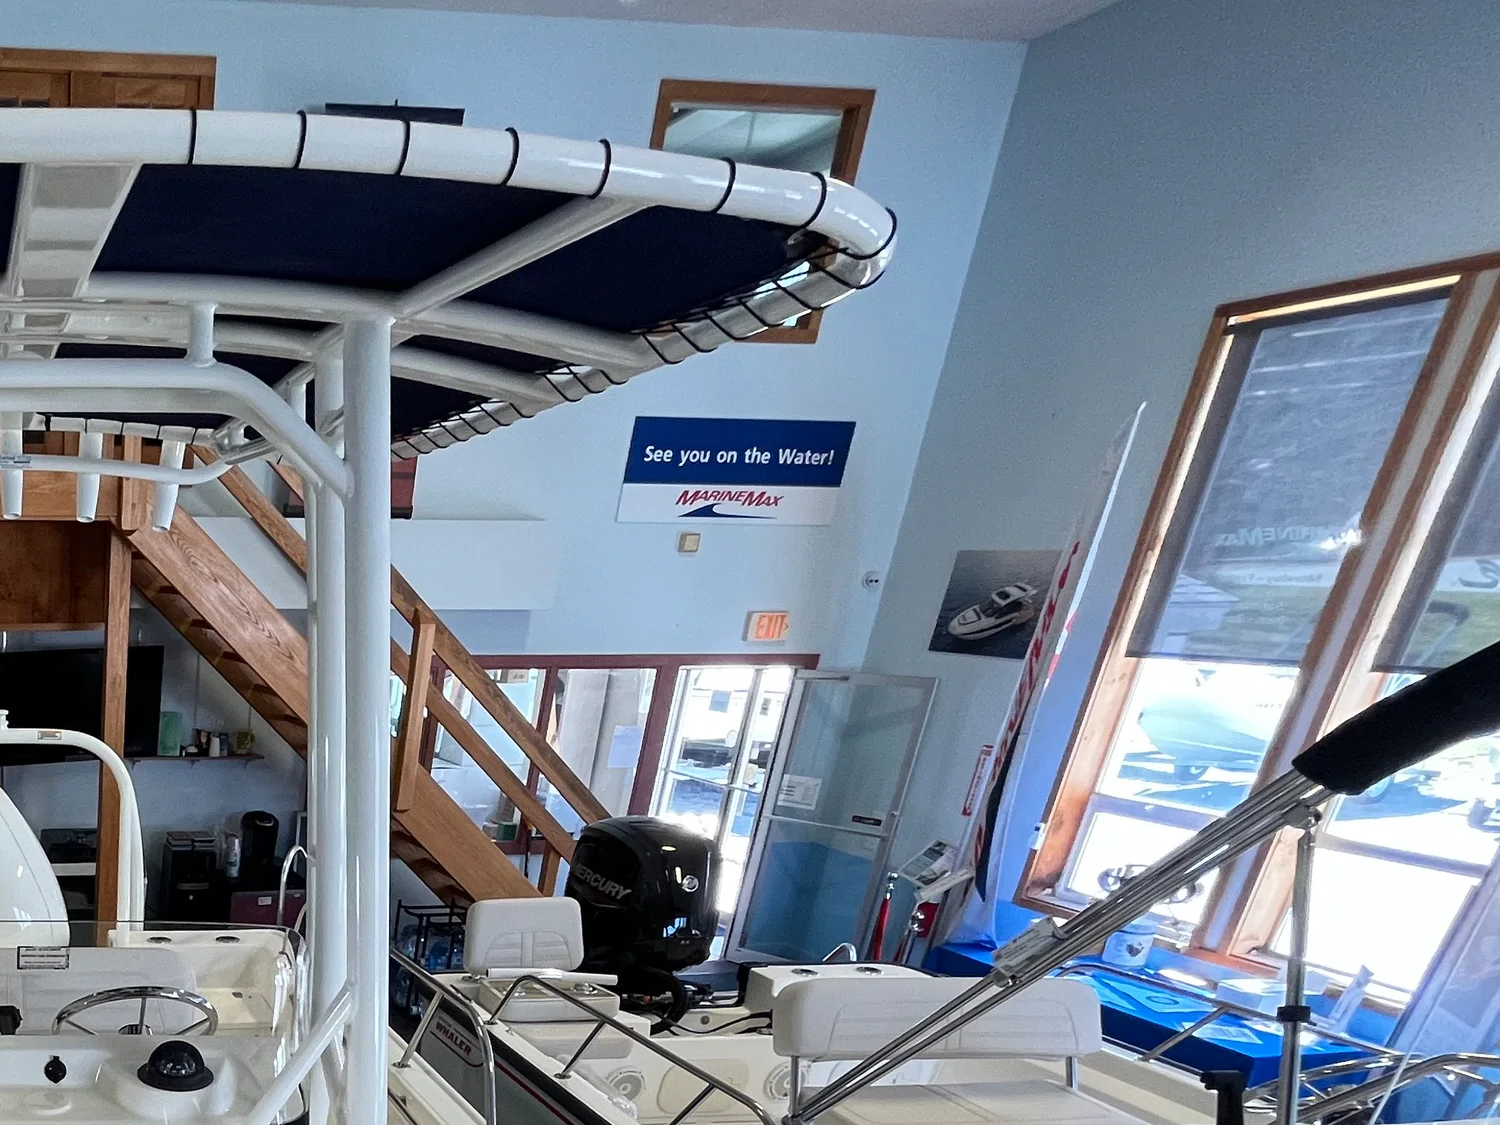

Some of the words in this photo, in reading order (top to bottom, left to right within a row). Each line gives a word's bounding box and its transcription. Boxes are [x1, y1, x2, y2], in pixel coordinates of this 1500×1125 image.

[643, 446, 673, 462] See
[679, 450, 711, 467] you
[716, 450, 738, 463] on
[744, 447, 771, 464] the
[778, 448, 835, 465] Water!
[675, 489, 784, 507] MARINEMAX
[754, 612, 787, 640] EXIT
[435, 1020, 473, 1056] WHALER
